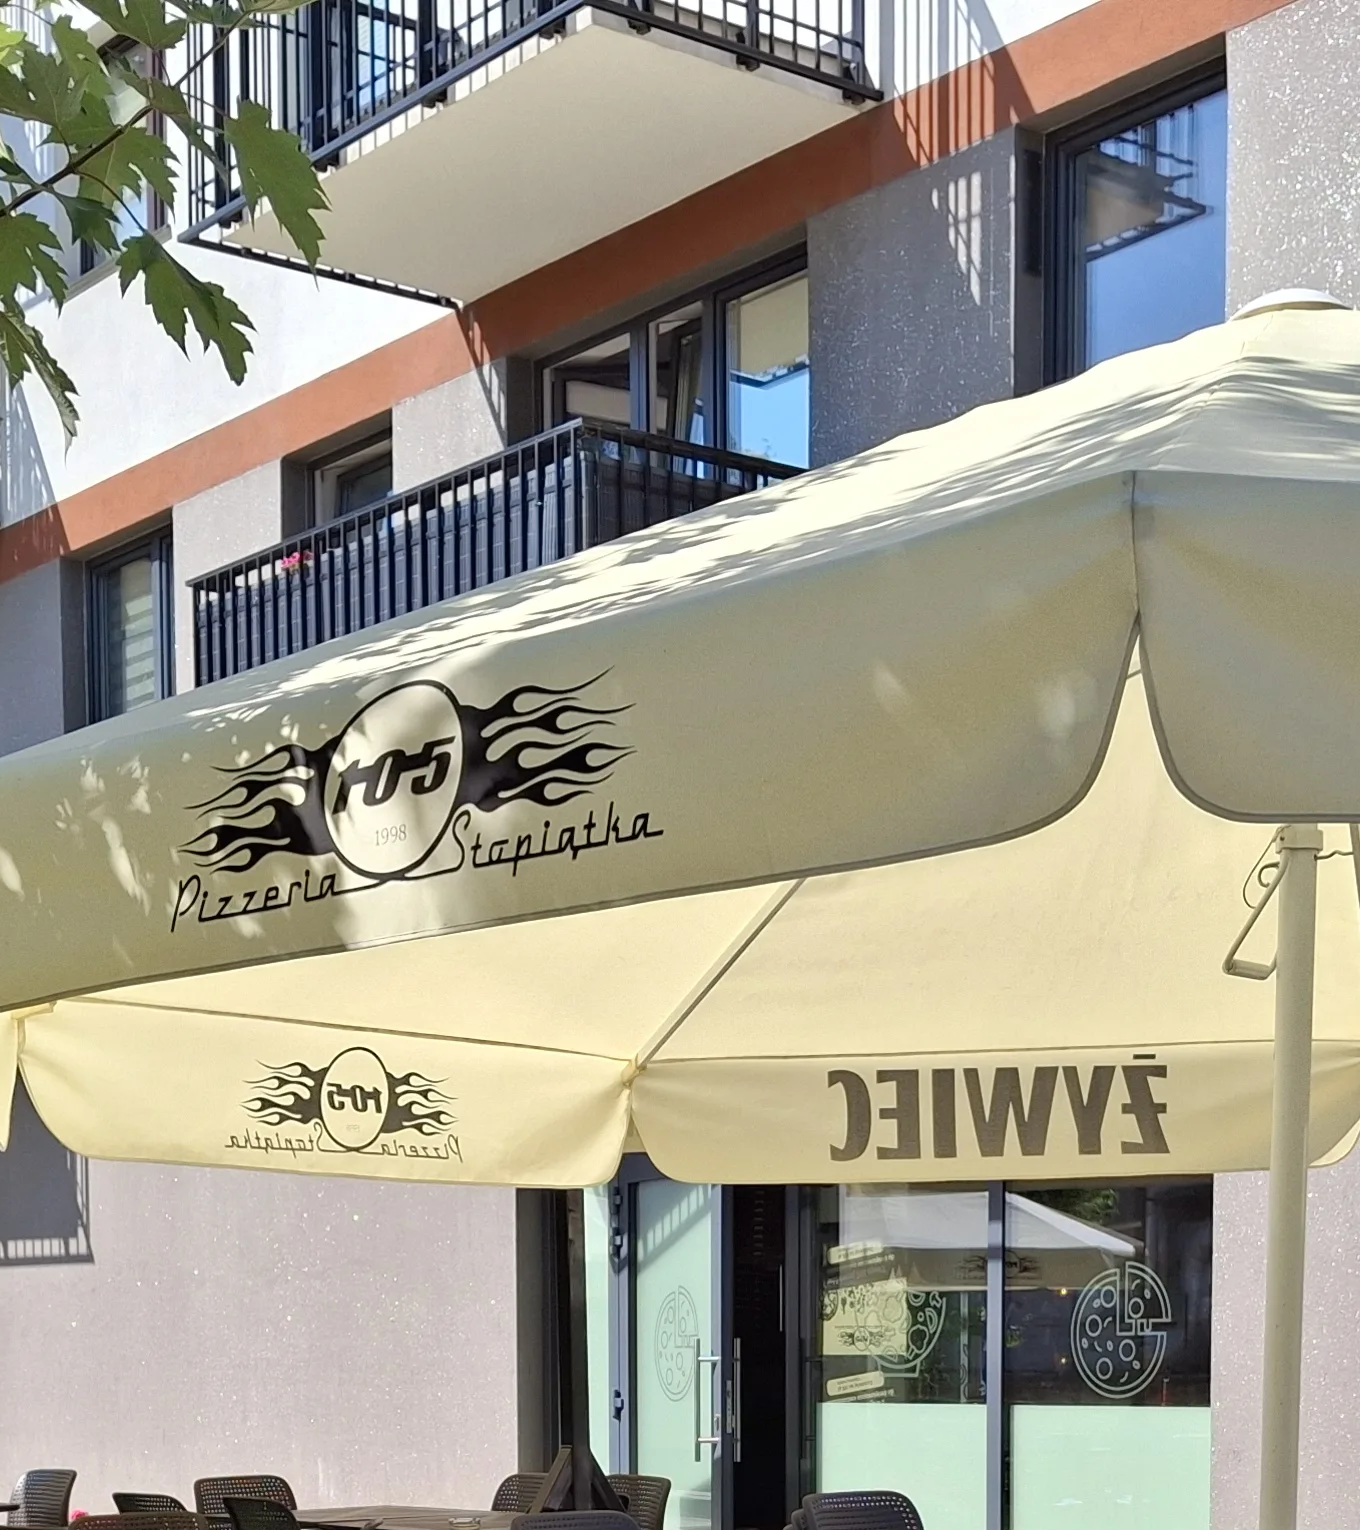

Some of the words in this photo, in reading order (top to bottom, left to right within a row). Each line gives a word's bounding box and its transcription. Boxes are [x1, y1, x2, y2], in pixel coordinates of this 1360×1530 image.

[332, 735, 456, 815] 105
[373, 823, 408, 847] 1998
[170, 869, 344, 933] Pizzeria
